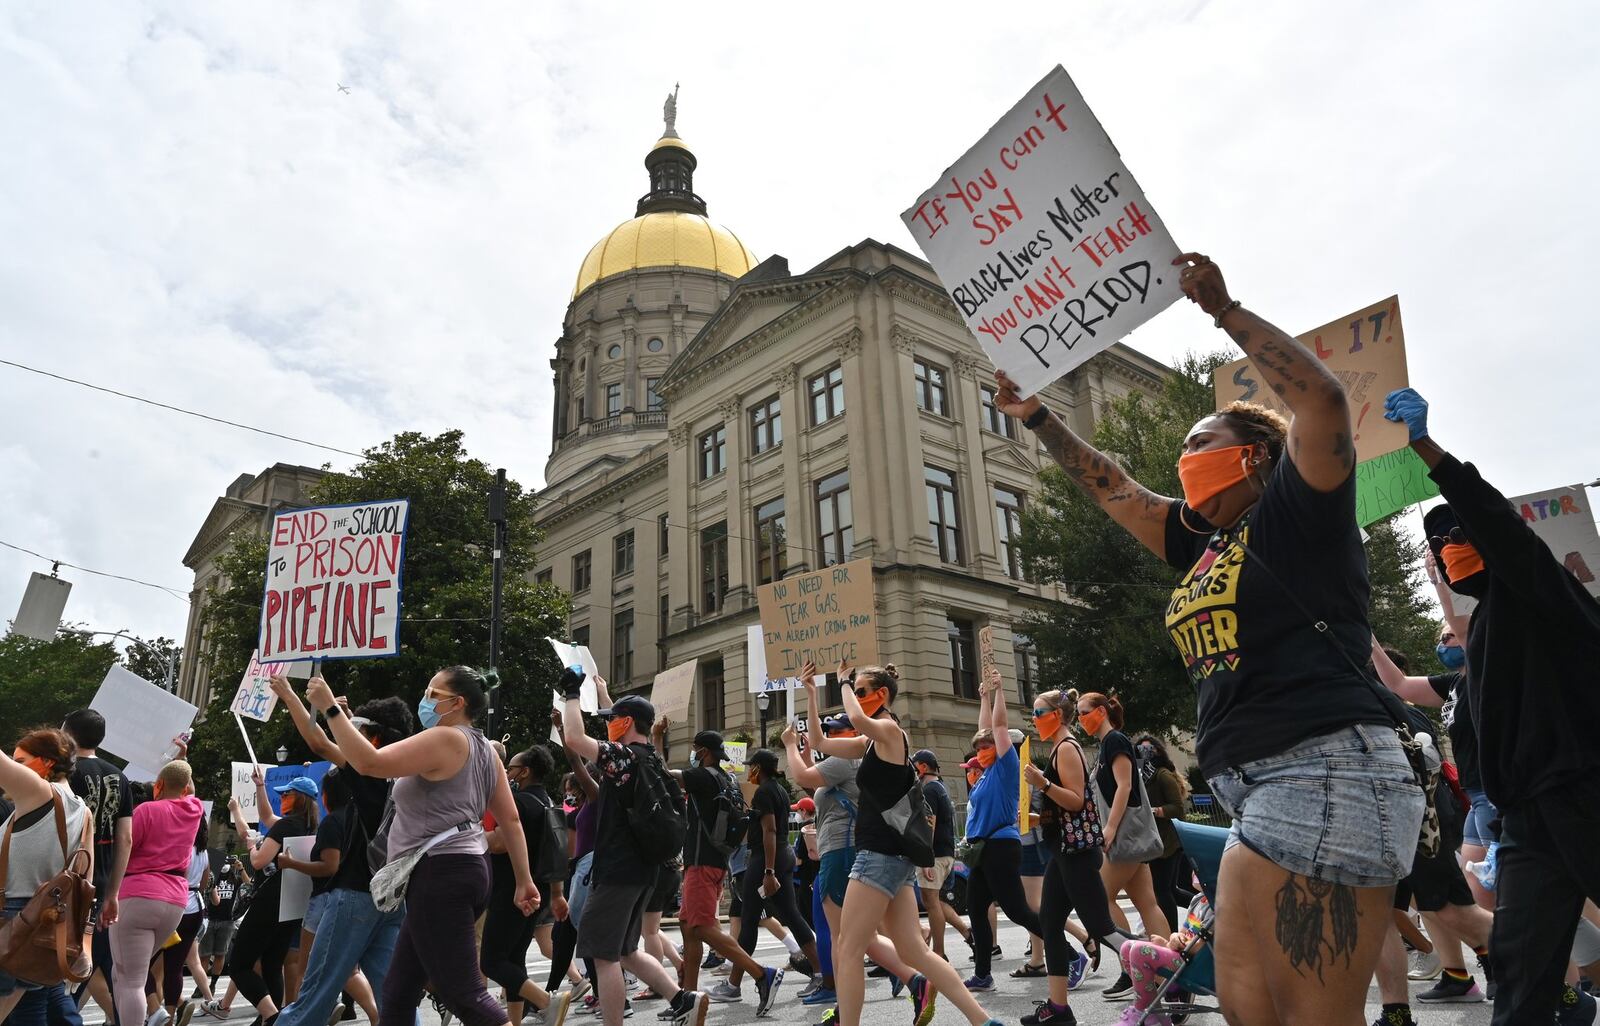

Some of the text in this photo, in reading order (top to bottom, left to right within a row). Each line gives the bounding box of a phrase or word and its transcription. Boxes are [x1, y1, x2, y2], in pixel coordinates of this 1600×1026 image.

[911, 194, 949, 239] If
[1000, 93, 1068, 170] can't
[973, 188, 1023, 245] SAY
[1072, 202, 1152, 267] TEACH
[952, 172, 1120, 318] BLACK Lives Matter
[1019, 260, 1162, 369] PERIOD.
[1349, 302, 1398, 354] IT!
[274, 505, 403, 547] END THE SCHOOL
[1520, 495, 1581, 522] ATOR
[294, 535, 400, 584] PRISON
[773, 567, 852, 601] NO NEED FOR
[263, 579, 392, 657] PIPELINE
[764, 631, 782, 645] I'M
[786, 624, 820, 643] ALREADY
[849, 614, 871, 628] FROM
[780, 593, 840, 627] TEAR GAS,
[780, 642, 857, 671] INJUSTICE
[1171, 609, 1239, 668] ATTER
